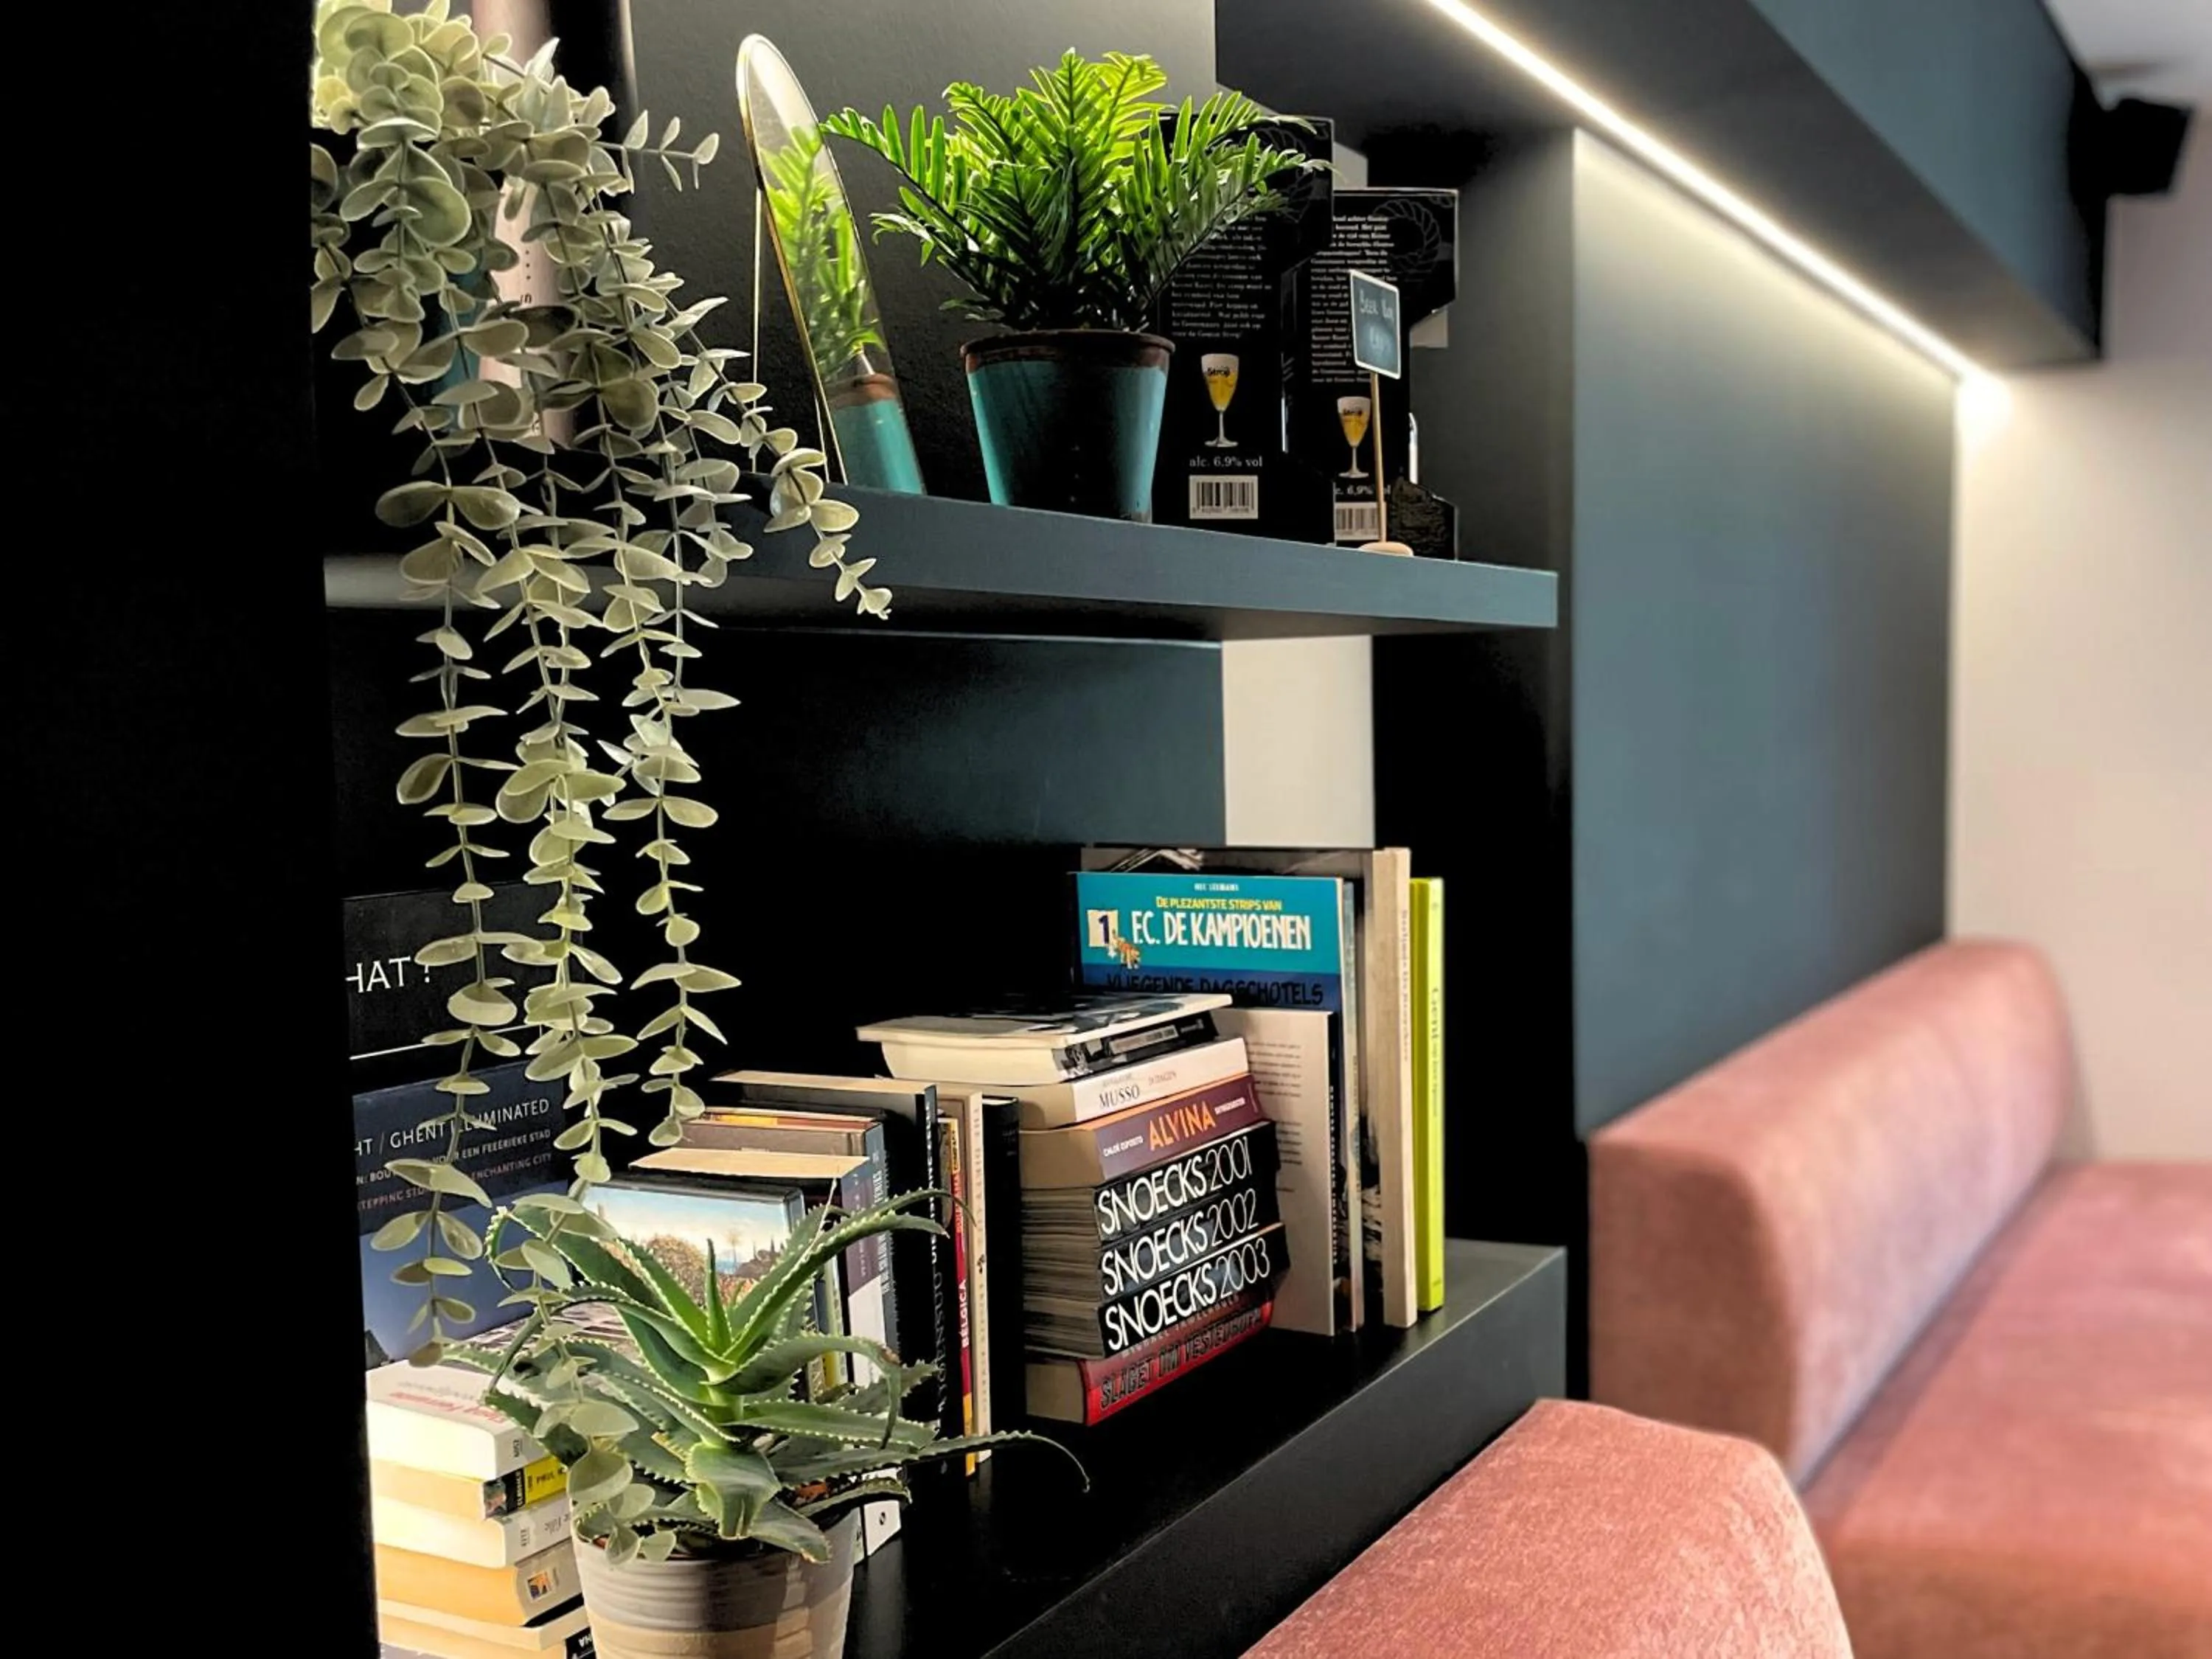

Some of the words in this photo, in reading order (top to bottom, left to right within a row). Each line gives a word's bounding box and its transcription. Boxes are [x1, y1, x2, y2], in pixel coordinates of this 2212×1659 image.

[1245, 456, 1263, 467] vol
[1155, 896, 1169, 908] DE
[1169, 897, 1228, 910] PLEZANTSTE
[1228, 899, 1262, 911] STRIPS
[1262, 900, 1282, 911] VAN
[1098, 914, 1110, 945] 1
[1163, 911, 1188, 945] DE
[1190, 911, 1312, 950] KAMPIOENEN
[1099, 1084, 1140, 1108] MUSSO
[390, 1121, 445, 1148] GHENT
[529, 1129, 551, 1141] STAD
[1149, 1101, 1217, 1152] ALVINA
[532, 1152, 552, 1165] CITY
[1098, 1155, 1207, 1234] SNOECKS
[1206, 1136, 1253, 1192] 2001
[1102, 1210, 1208, 1296] SNOECKS
[1207, 1188, 1259, 1247] 2002
[1105, 1262, 1217, 1351] SNOECKS
[1216, 1237, 1270, 1298] 2003
